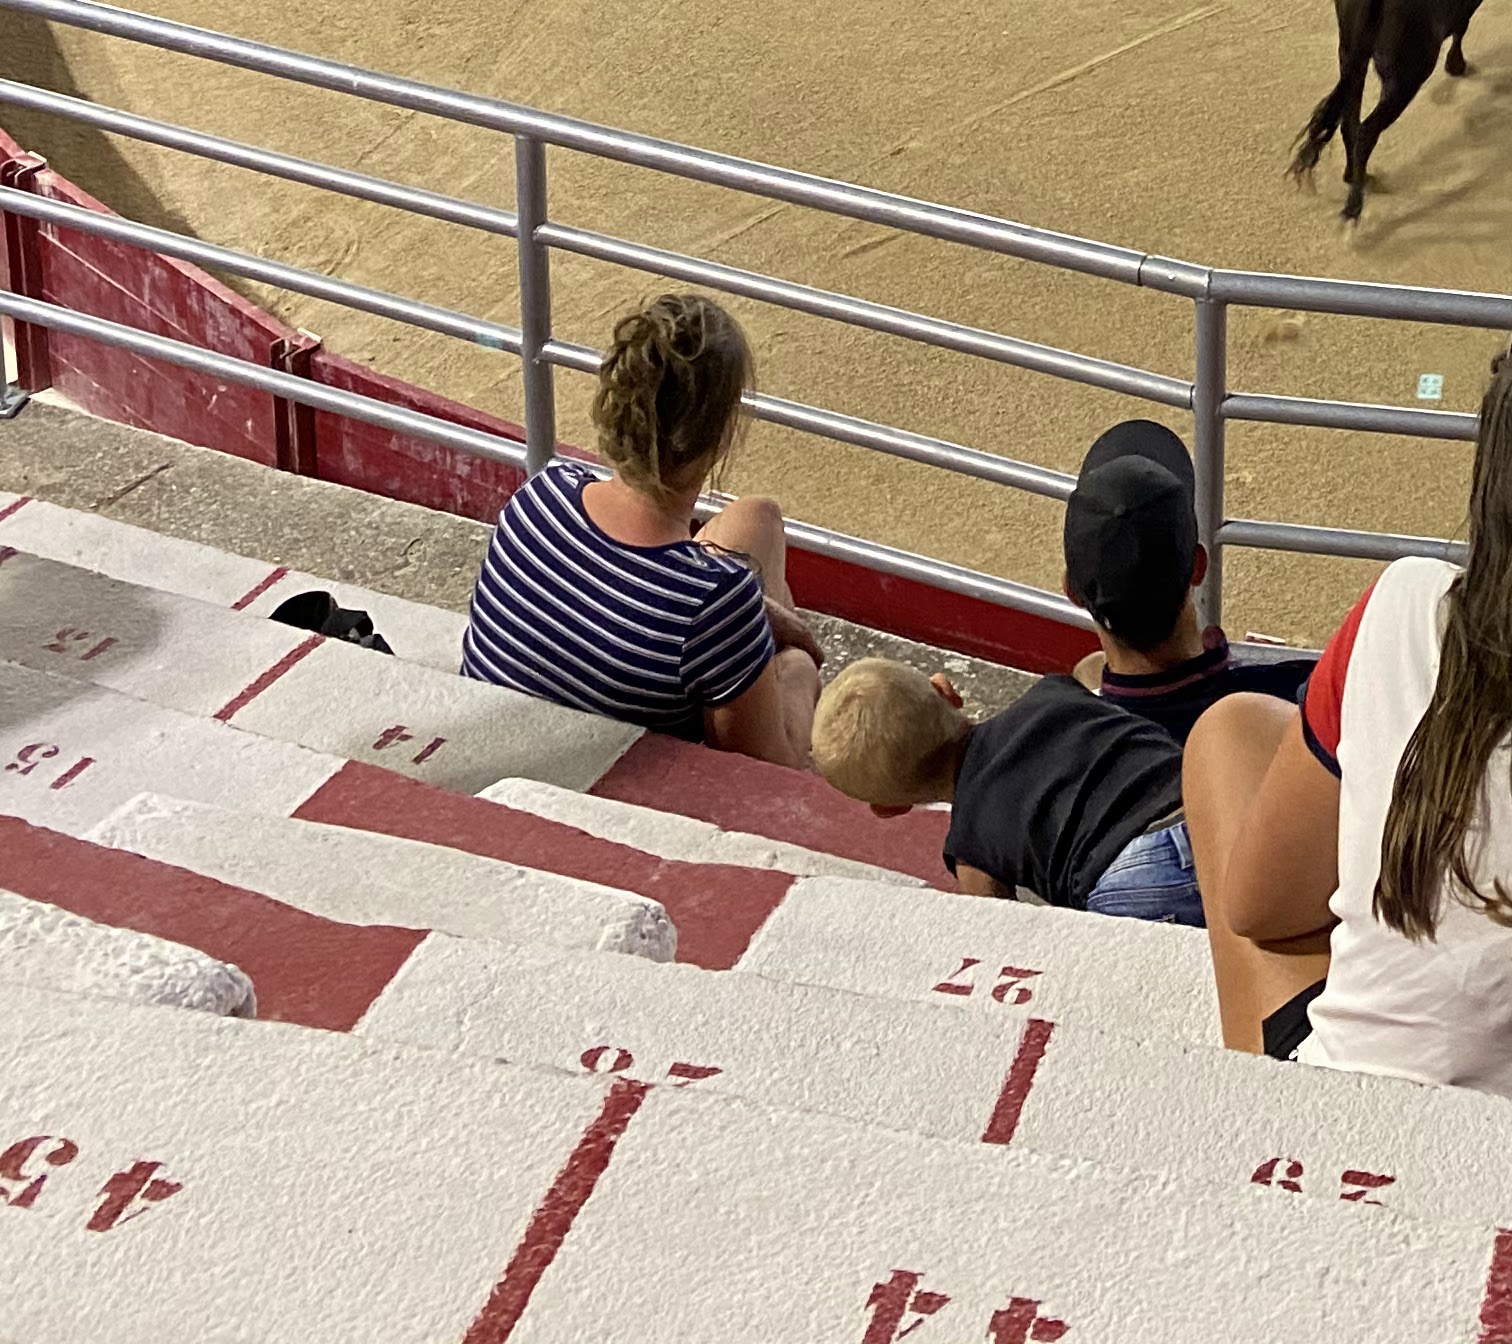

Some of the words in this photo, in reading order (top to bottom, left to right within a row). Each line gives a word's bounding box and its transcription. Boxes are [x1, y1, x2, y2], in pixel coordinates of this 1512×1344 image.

[4, 741, 97, 790] 15
[372, 724, 448, 765] 14
[932, 956, 1045, 1005] 27
[0, 1135, 184, 1232] 45
